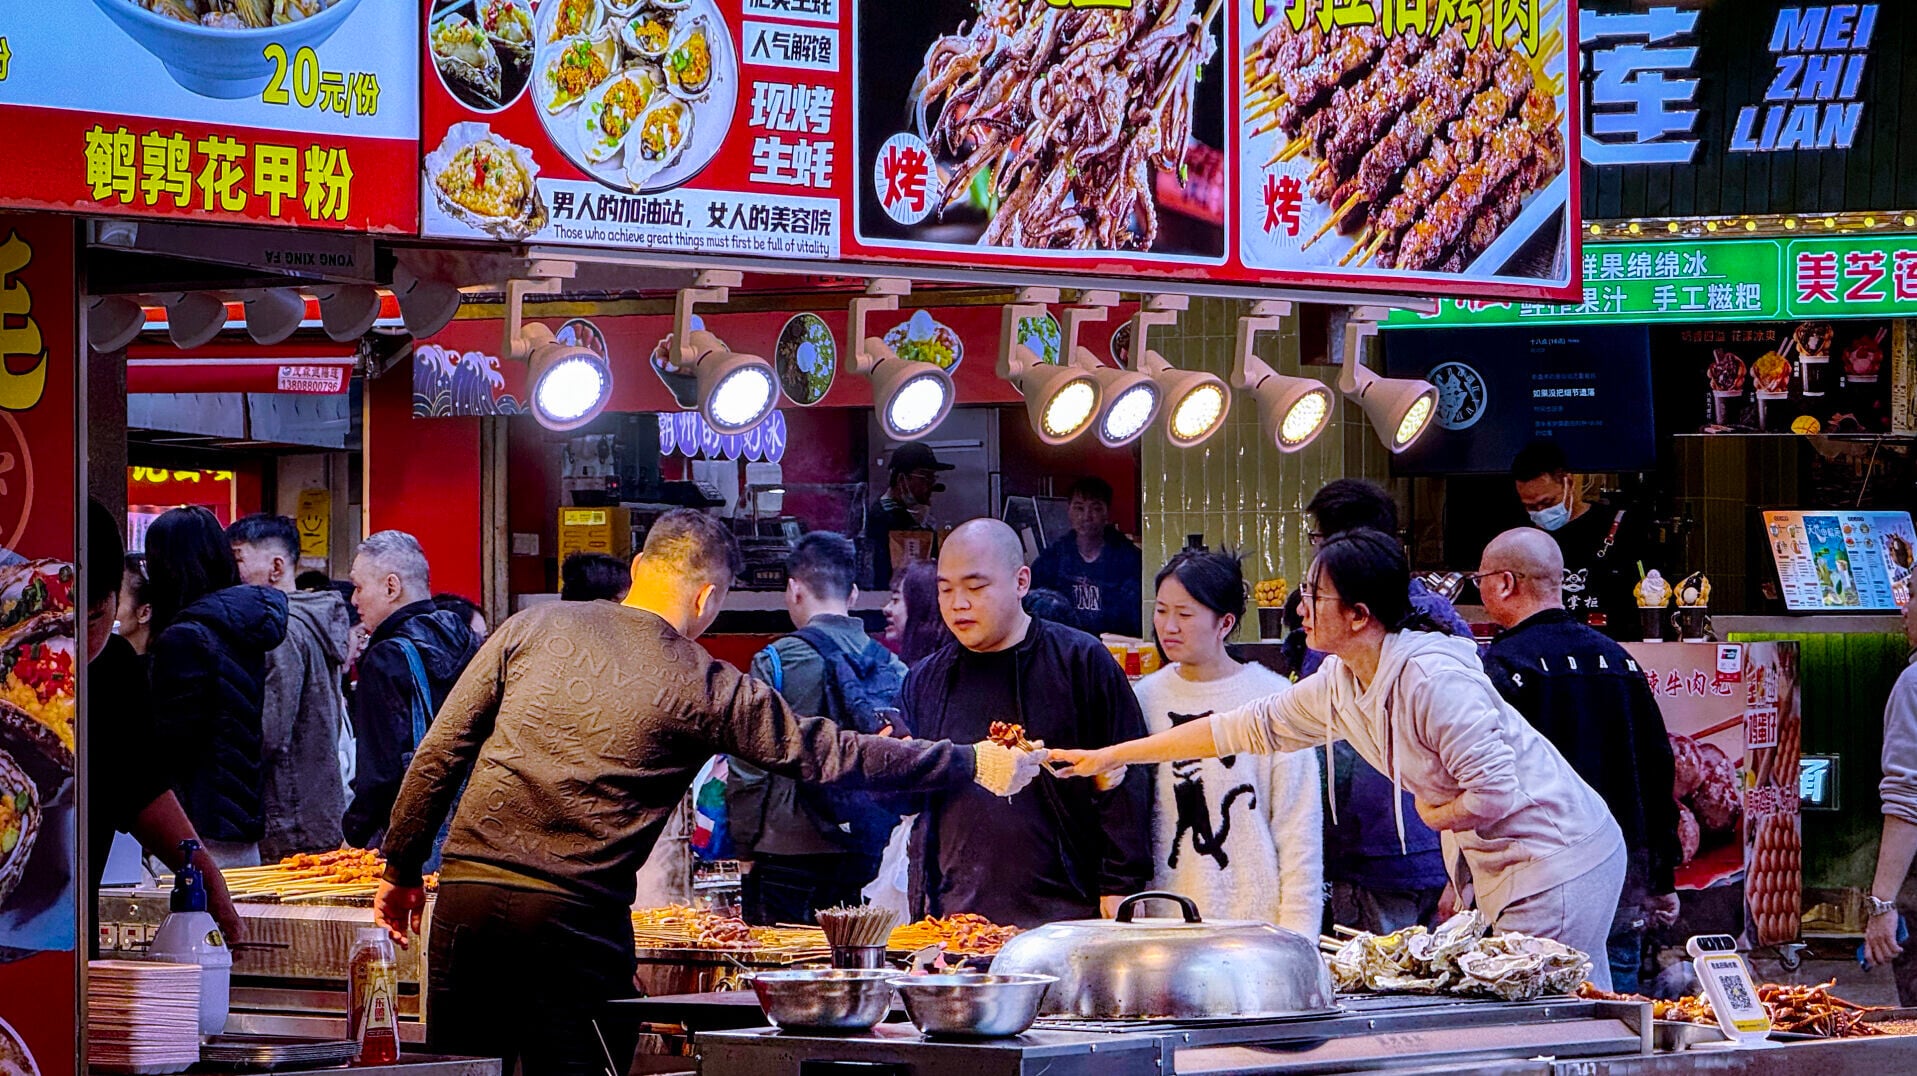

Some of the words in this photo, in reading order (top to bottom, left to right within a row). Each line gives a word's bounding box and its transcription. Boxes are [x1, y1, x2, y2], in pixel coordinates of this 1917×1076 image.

[750, 29, 832, 64] 人气解馋
[1769, 4, 1880, 52] MEI
[261, 43, 380, 117] 20元/份
[1763, 54, 1868, 101] ZHI
[749, 80, 833, 134] 现烤
[1729, 101, 1864, 152] LIAN
[83, 124, 354, 222] 鹌鹑花甲粉
[749, 136, 833, 189] 生蚝
[884, 145, 928, 214] 烤
[1263, 174, 1303, 237] 烤
[264, 250, 282, 264] FA
[284, 251, 316, 267] XING
[319, 253, 354, 268] YONG
[553, 223, 583, 240] Those
[584, 226, 606, 241] who
[607, 228, 645, 244] achieve
[647, 231, 674, 248] great
[675, 231, 705, 251] things
[706, 235, 730, 249] must
[731, 235, 752, 250] first
[753, 236, 766, 251] be
[767, 238, 783, 252] full
[784, 238, 796, 253] of
[796, 239, 831, 259] vitality
[280, 379, 339, 393] 13808800796
